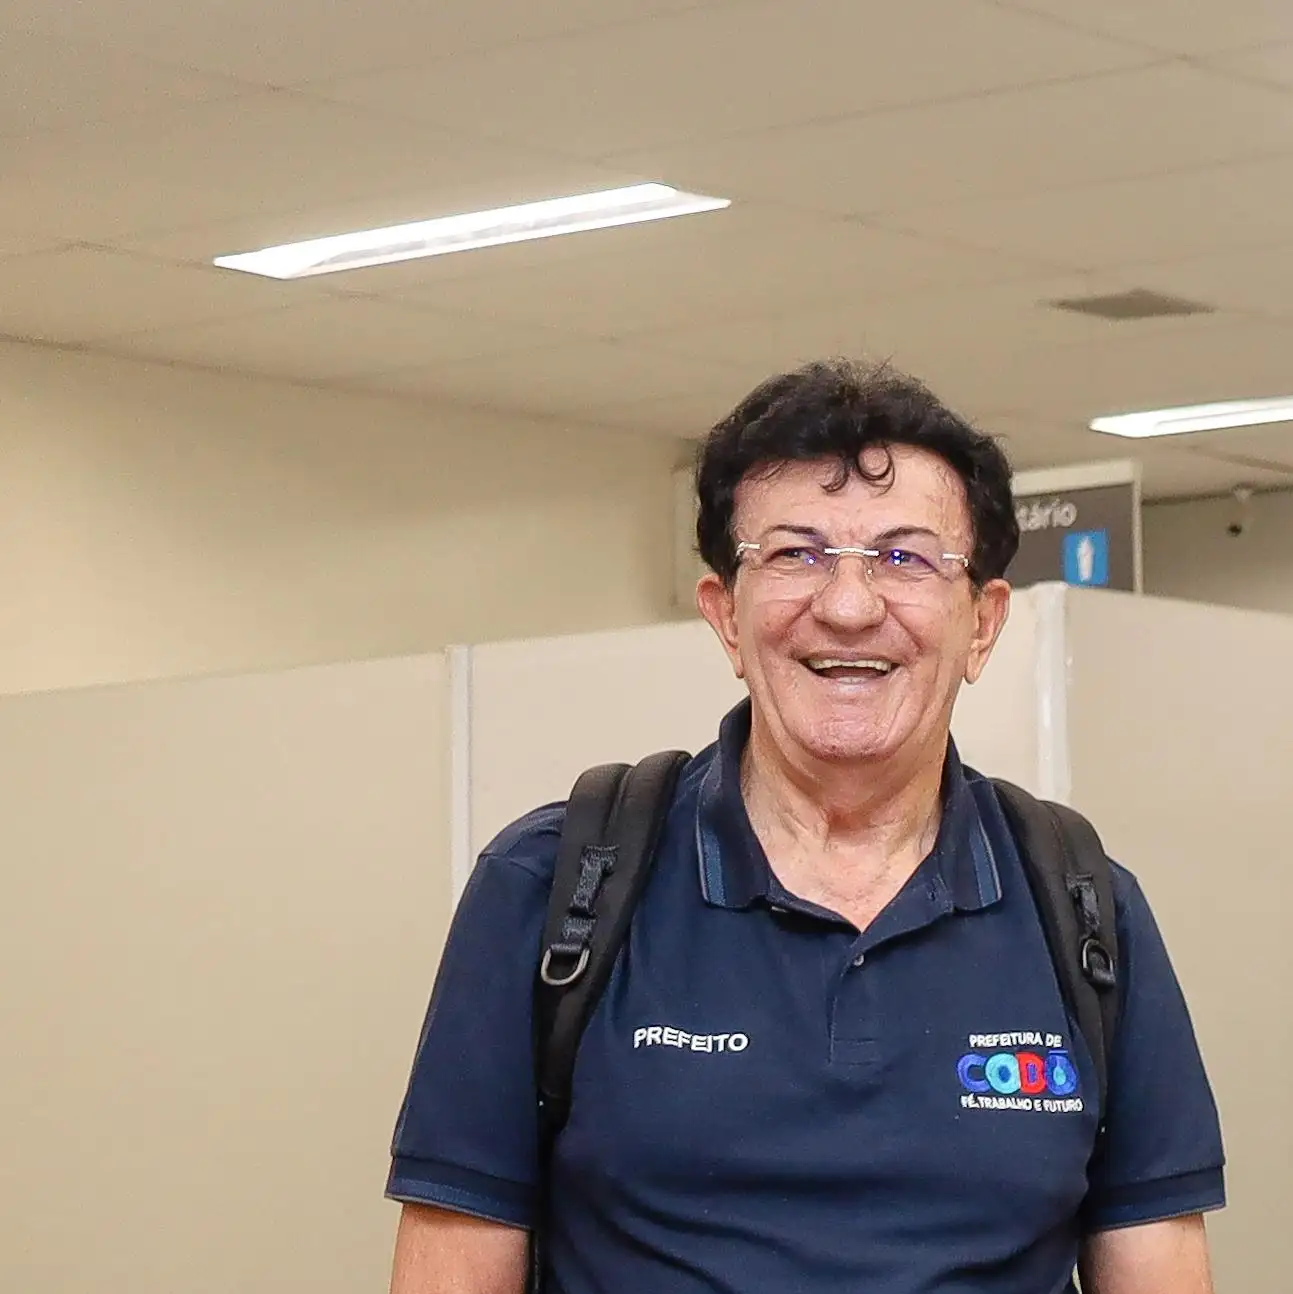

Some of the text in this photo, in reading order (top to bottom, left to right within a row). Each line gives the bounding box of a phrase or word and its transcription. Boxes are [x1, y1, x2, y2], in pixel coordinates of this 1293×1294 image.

[1015, 499, 1078, 532] tário
[633, 1026, 749, 1053] PREFEITO
[969, 1032, 1062, 1048] PREFEITURA DE
[1034, 1099, 1043, 1111] E
[1043, 1098, 1084, 1113] FUTURO
